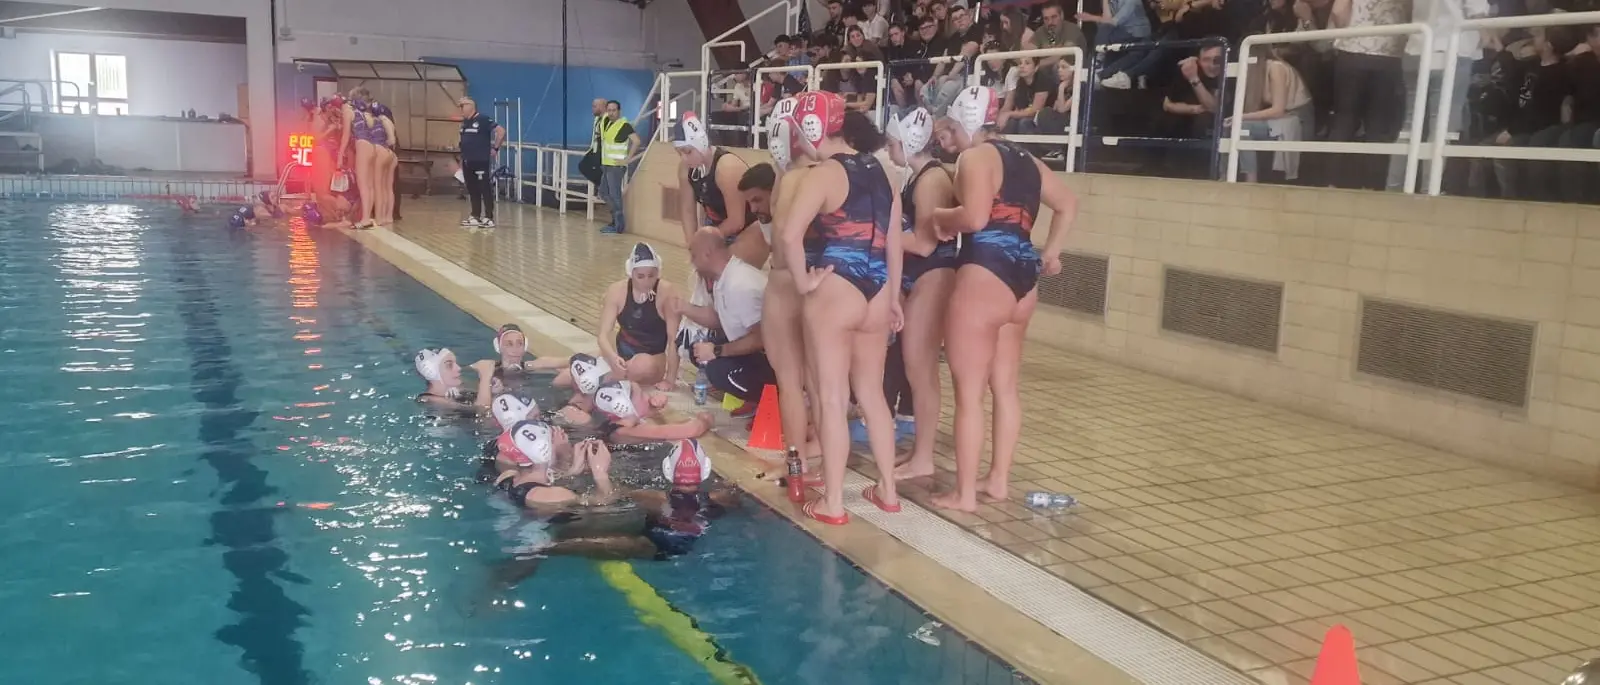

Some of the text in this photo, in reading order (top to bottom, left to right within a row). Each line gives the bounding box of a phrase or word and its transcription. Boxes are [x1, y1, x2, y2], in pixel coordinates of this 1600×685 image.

[970, 87, 979, 100] 4
[780, 100, 792, 114] 10
[803, 95, 817, 111] 13
[913, 110, 926, 127] 14
[687, 121, 698, 132] 2
[772, 122, 781, 137] 11
[600, 392, 613, 402] 5
[499, 398, 509, 412] 3
[522, 429, 537, 442] 6
